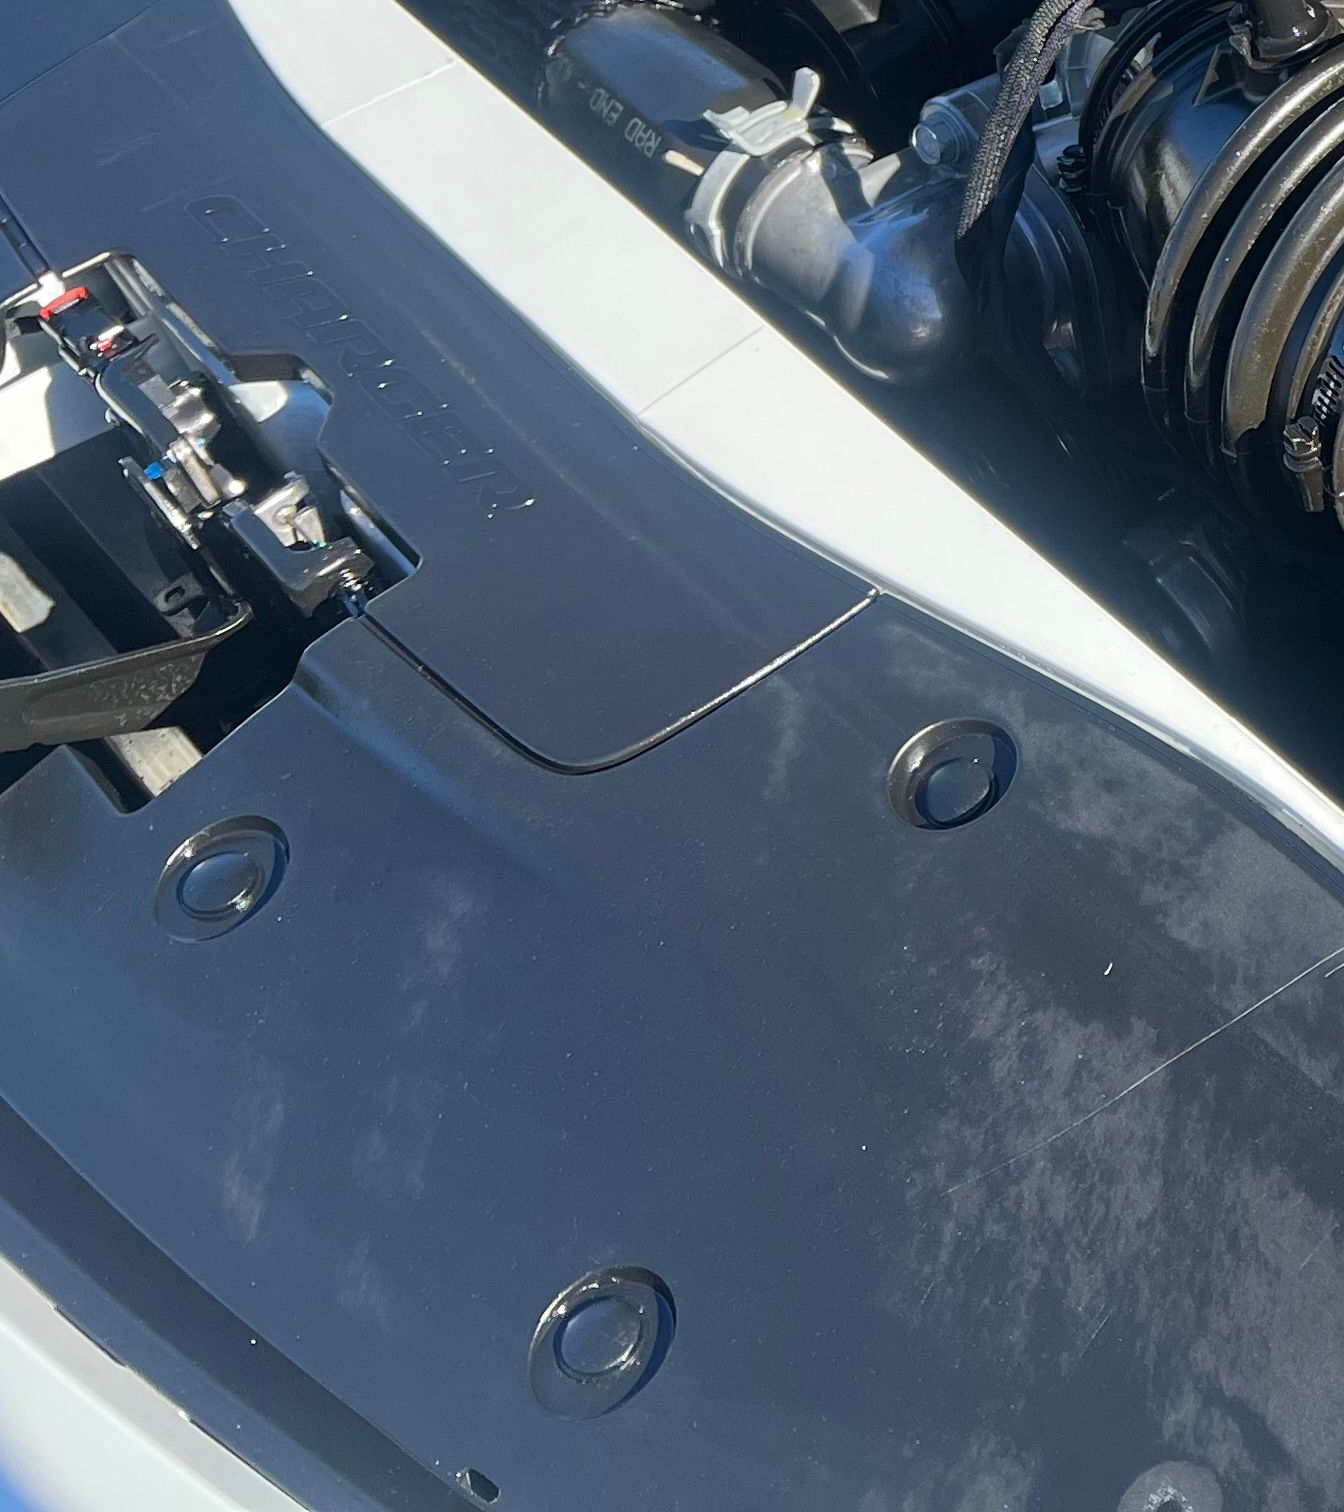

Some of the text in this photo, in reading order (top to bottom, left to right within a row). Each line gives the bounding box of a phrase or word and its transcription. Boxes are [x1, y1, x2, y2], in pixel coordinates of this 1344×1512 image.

[588, 88, 661, 159] RAD END
[186, 194, 536, 519] CHARGER
